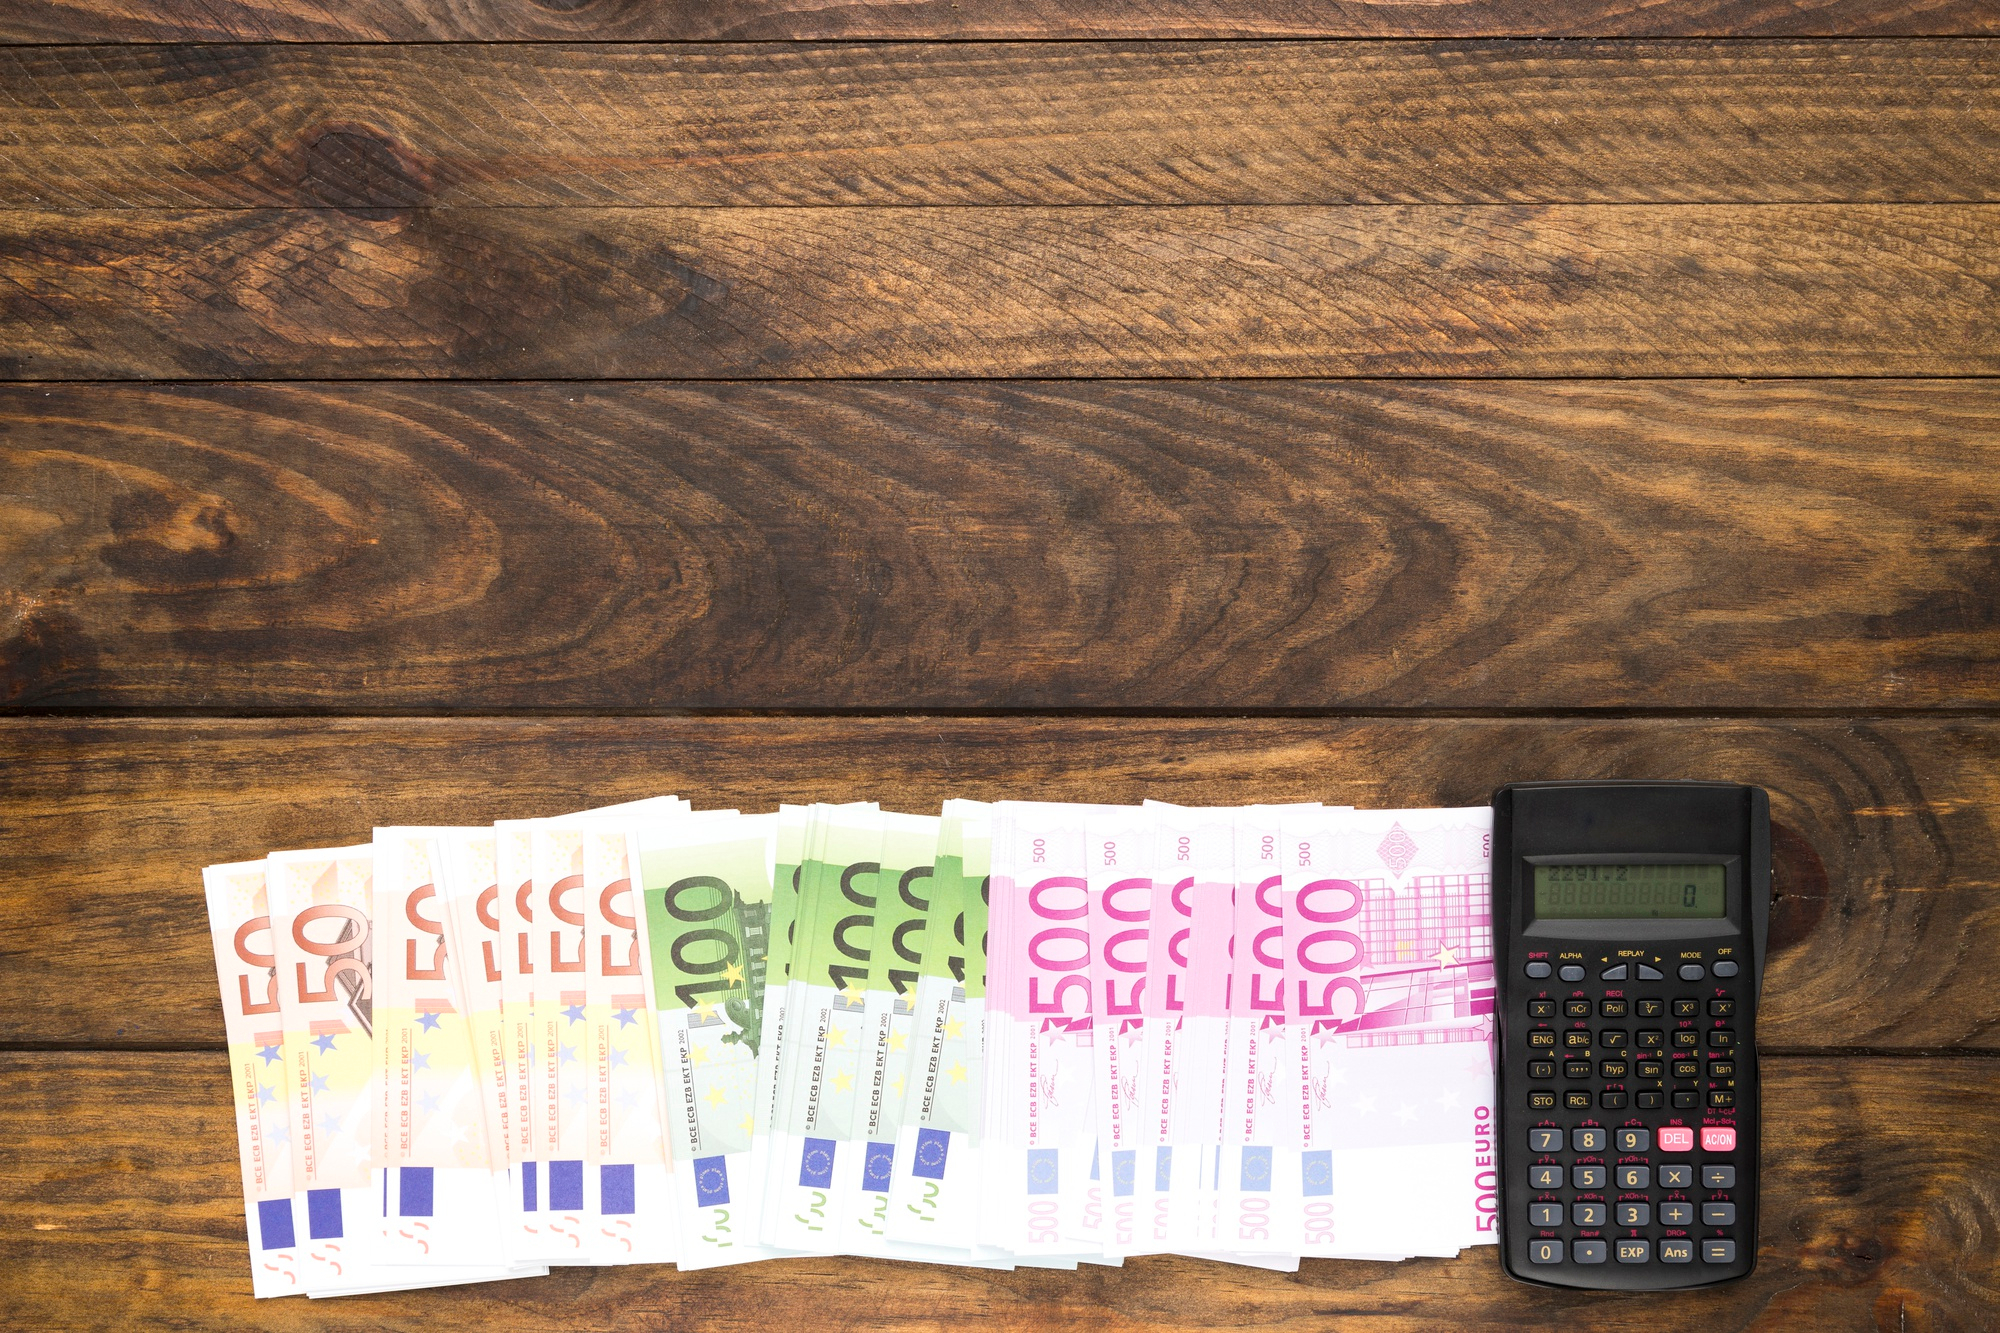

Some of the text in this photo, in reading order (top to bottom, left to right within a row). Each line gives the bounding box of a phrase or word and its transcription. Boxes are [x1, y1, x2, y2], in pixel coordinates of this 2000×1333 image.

[1033, 839, 1045, 863] 500
[1104, 841, 1116, 866] 500
[1178, 836, 1190, 861] 500
[1262, 835, 1274, 860] 500
[1299, 842, 1311, 866] 500
[1389, 831, 1406, 868] 500
[828, 862, 880, 991] 100
[664, 876, 742, 1009] 100
[1029, 877, 1092, 1013] 500
[1102, 878, 1152, 1015] 500
[1296, 879, 1365, 1016] 500
[292, 904, 372, 1003] 50
[1606, 990, 1624, 998] REC(
[1571, 1004, 1587, 1013] nCr
[1606, 1004, 1624, 1013] Pol(
[1532, 1035, 1554, 1044] ENG
[1680, 1034, 1696, 1044] log
[401, 1046, 409, 1065] EKP
[922, 999, 946, 1113] BCE ECB EZB EKT EKP 2002
[806, 1008, 828, 1122] BCE ECB EZB EKT EKP 2002
[868, 1012, 888, 1127] BCE ECB EZB EKT EKP 2002
[1110, 1064, 1118, 1080] EKT
[1248, 1058, 1256, 1075] EKT
[1606, 1064, 1625, 1075] hyp
[1645, 1065, 1659, 1074] sin
[1679, 1065, 1696, 1073] cos
[1716, 1065, 1732, 1074] tan
[401, 1068, 409, 1085] EKT
[1111, 1084, 1119, 1100] EZB
[1162, 1079, 1170, 1095] EZB
[1247, 1078, 1255, 1095] EZB
[1302, 1084, 1310, 1100] EZB
[301, 1091, 309, 1109] EKT
[680, 1047, 698, 1144] BCE ECB EZB EKT EKP
[1533, 1096, 1554, 1106] STO
[1569, 1096, 1589, 1106] RCL
[1161, 1098, 1169, 1115] ECB
[1246, 1098, 1254, 1114] ECB
[1160, 1118, 1168, 1135] BCE
[1245, 1118, 1253, 1134] BCE
[1303, 1124, 1311, 1140] BCE
[304, 1133, 312, 1151] ECB
[400, 1131, 408, 1149] BCE
[1541, 1133, 1551, 1148] 7
[1583, 1133, 1594, 1148] 8
[1625, 1133, 1637, 1148] 9
[1664, 1133, 1690, 1144] DEL
[1705, 1134, 1732, 1146] AC/ON
[305, 1155, 313, 1172] BCE
[1540, 1170, 1552, 1185] 4
[1583, 1170, 1594, 1185] 5
[1626, 1170, 1638, 1185] 6
[1028, 1201, 1059, 1243] 500
[1239, 1197, 1270, 1240] 500
[1543, 1208, 1549, 1222] 1
[1584, 1208, 1594, 1222] 2
[1627, 1207, 1638, 1222] 3
[1304, 1202, 1335, 1245] 500
[1541, 1245, 1551, 1260] 0
[1620, 1247, 1644, 1258] EXP
[1664, 1247, 1688, 1258] Ans
